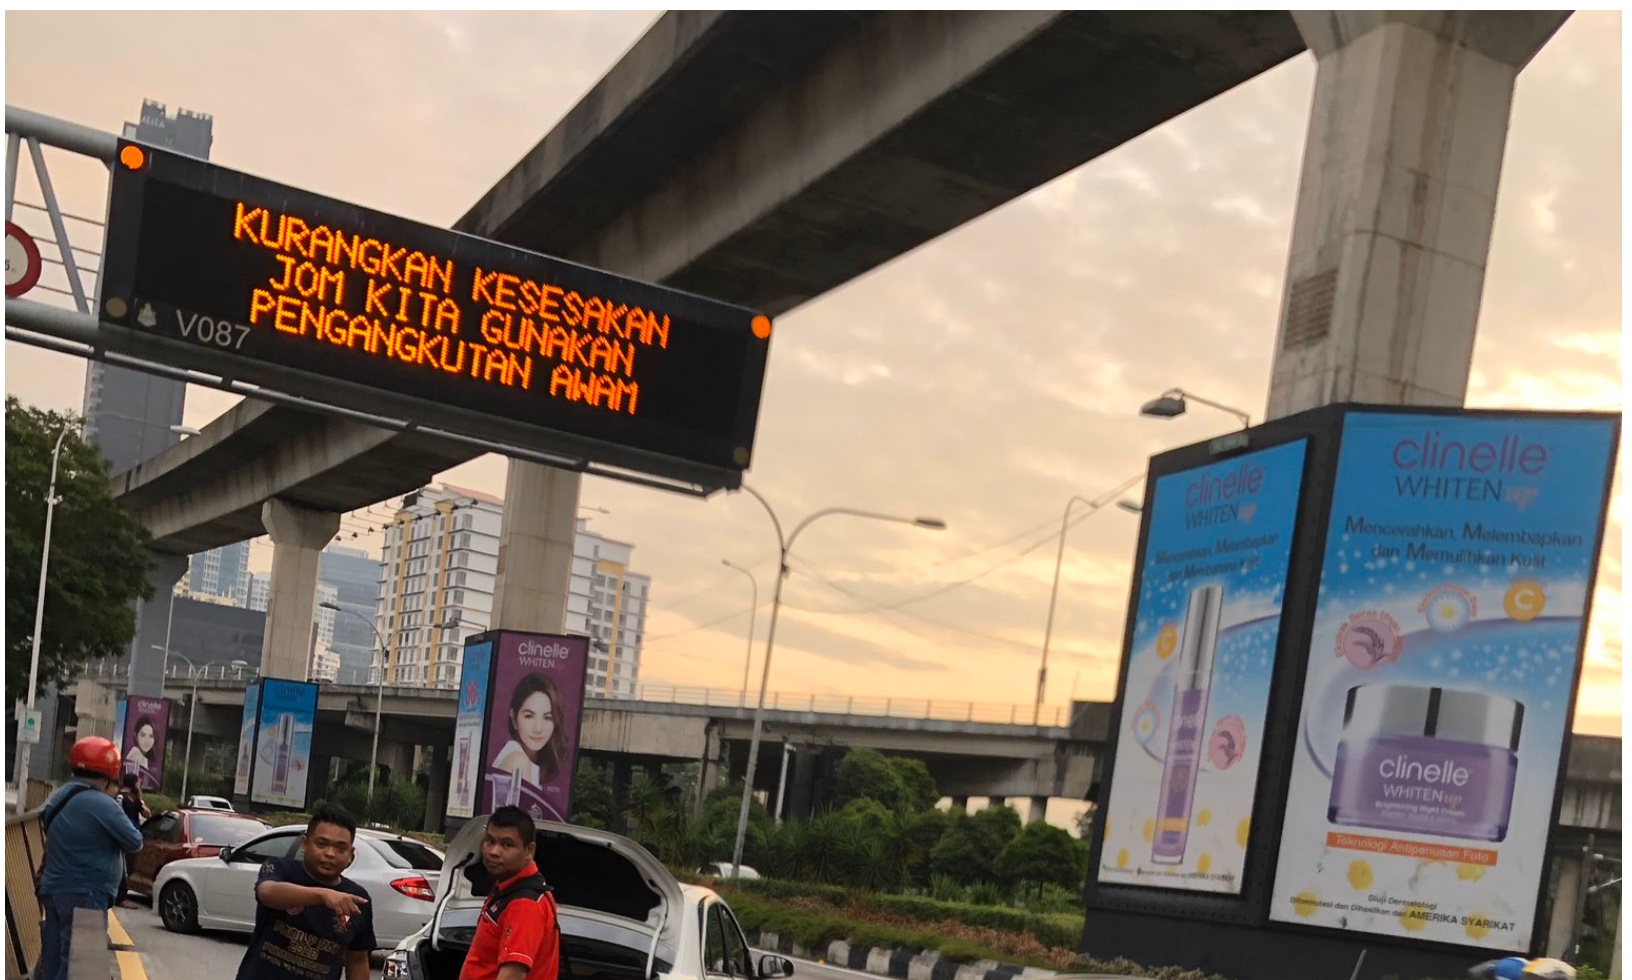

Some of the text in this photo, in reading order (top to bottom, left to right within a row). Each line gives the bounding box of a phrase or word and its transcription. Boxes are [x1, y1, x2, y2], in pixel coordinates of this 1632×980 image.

[234, 202, 671, 349] KURANGKAN KESESAKAN
[176, 309, 250, 349] V087
[269, 253, 635, 377] JOM KITA GUNAKAN
[249, 288, 639, 415] PENGANGKUTAN AWAM
[1392, 431, 1549, 475] clinelle
[1185, 461, 1263, 508] clinelle
[1395, 475, 1503, 501] WHITEN
[1185, 502, 1238, 530] WHITEN
[1462, 522, 1582, 548] Melembapkan
[1371, 543, 1400, 558] dan
[1509, 550, 1546, 568] Kulit
[518, 640, 569, 660] clinelle
[519, 656, 555, 669] WHITEN
[1379, 754, 1469, 787] clinelle
[1383, 784, 1444, 802] WHITEN
[1336, 835, 1388, 851] Teknologi
[1463, 851, 1489, 863] Foto
[1334, 902, 1349, 910] dan
[1350, 904, 1391, 916] Dihasilkan
[1408, 910, 1458, 924] AMERIKA
[1460, 917, 1516, 932] SYARIKAT
[1388, 896, 1438, 910] Dermatologi
